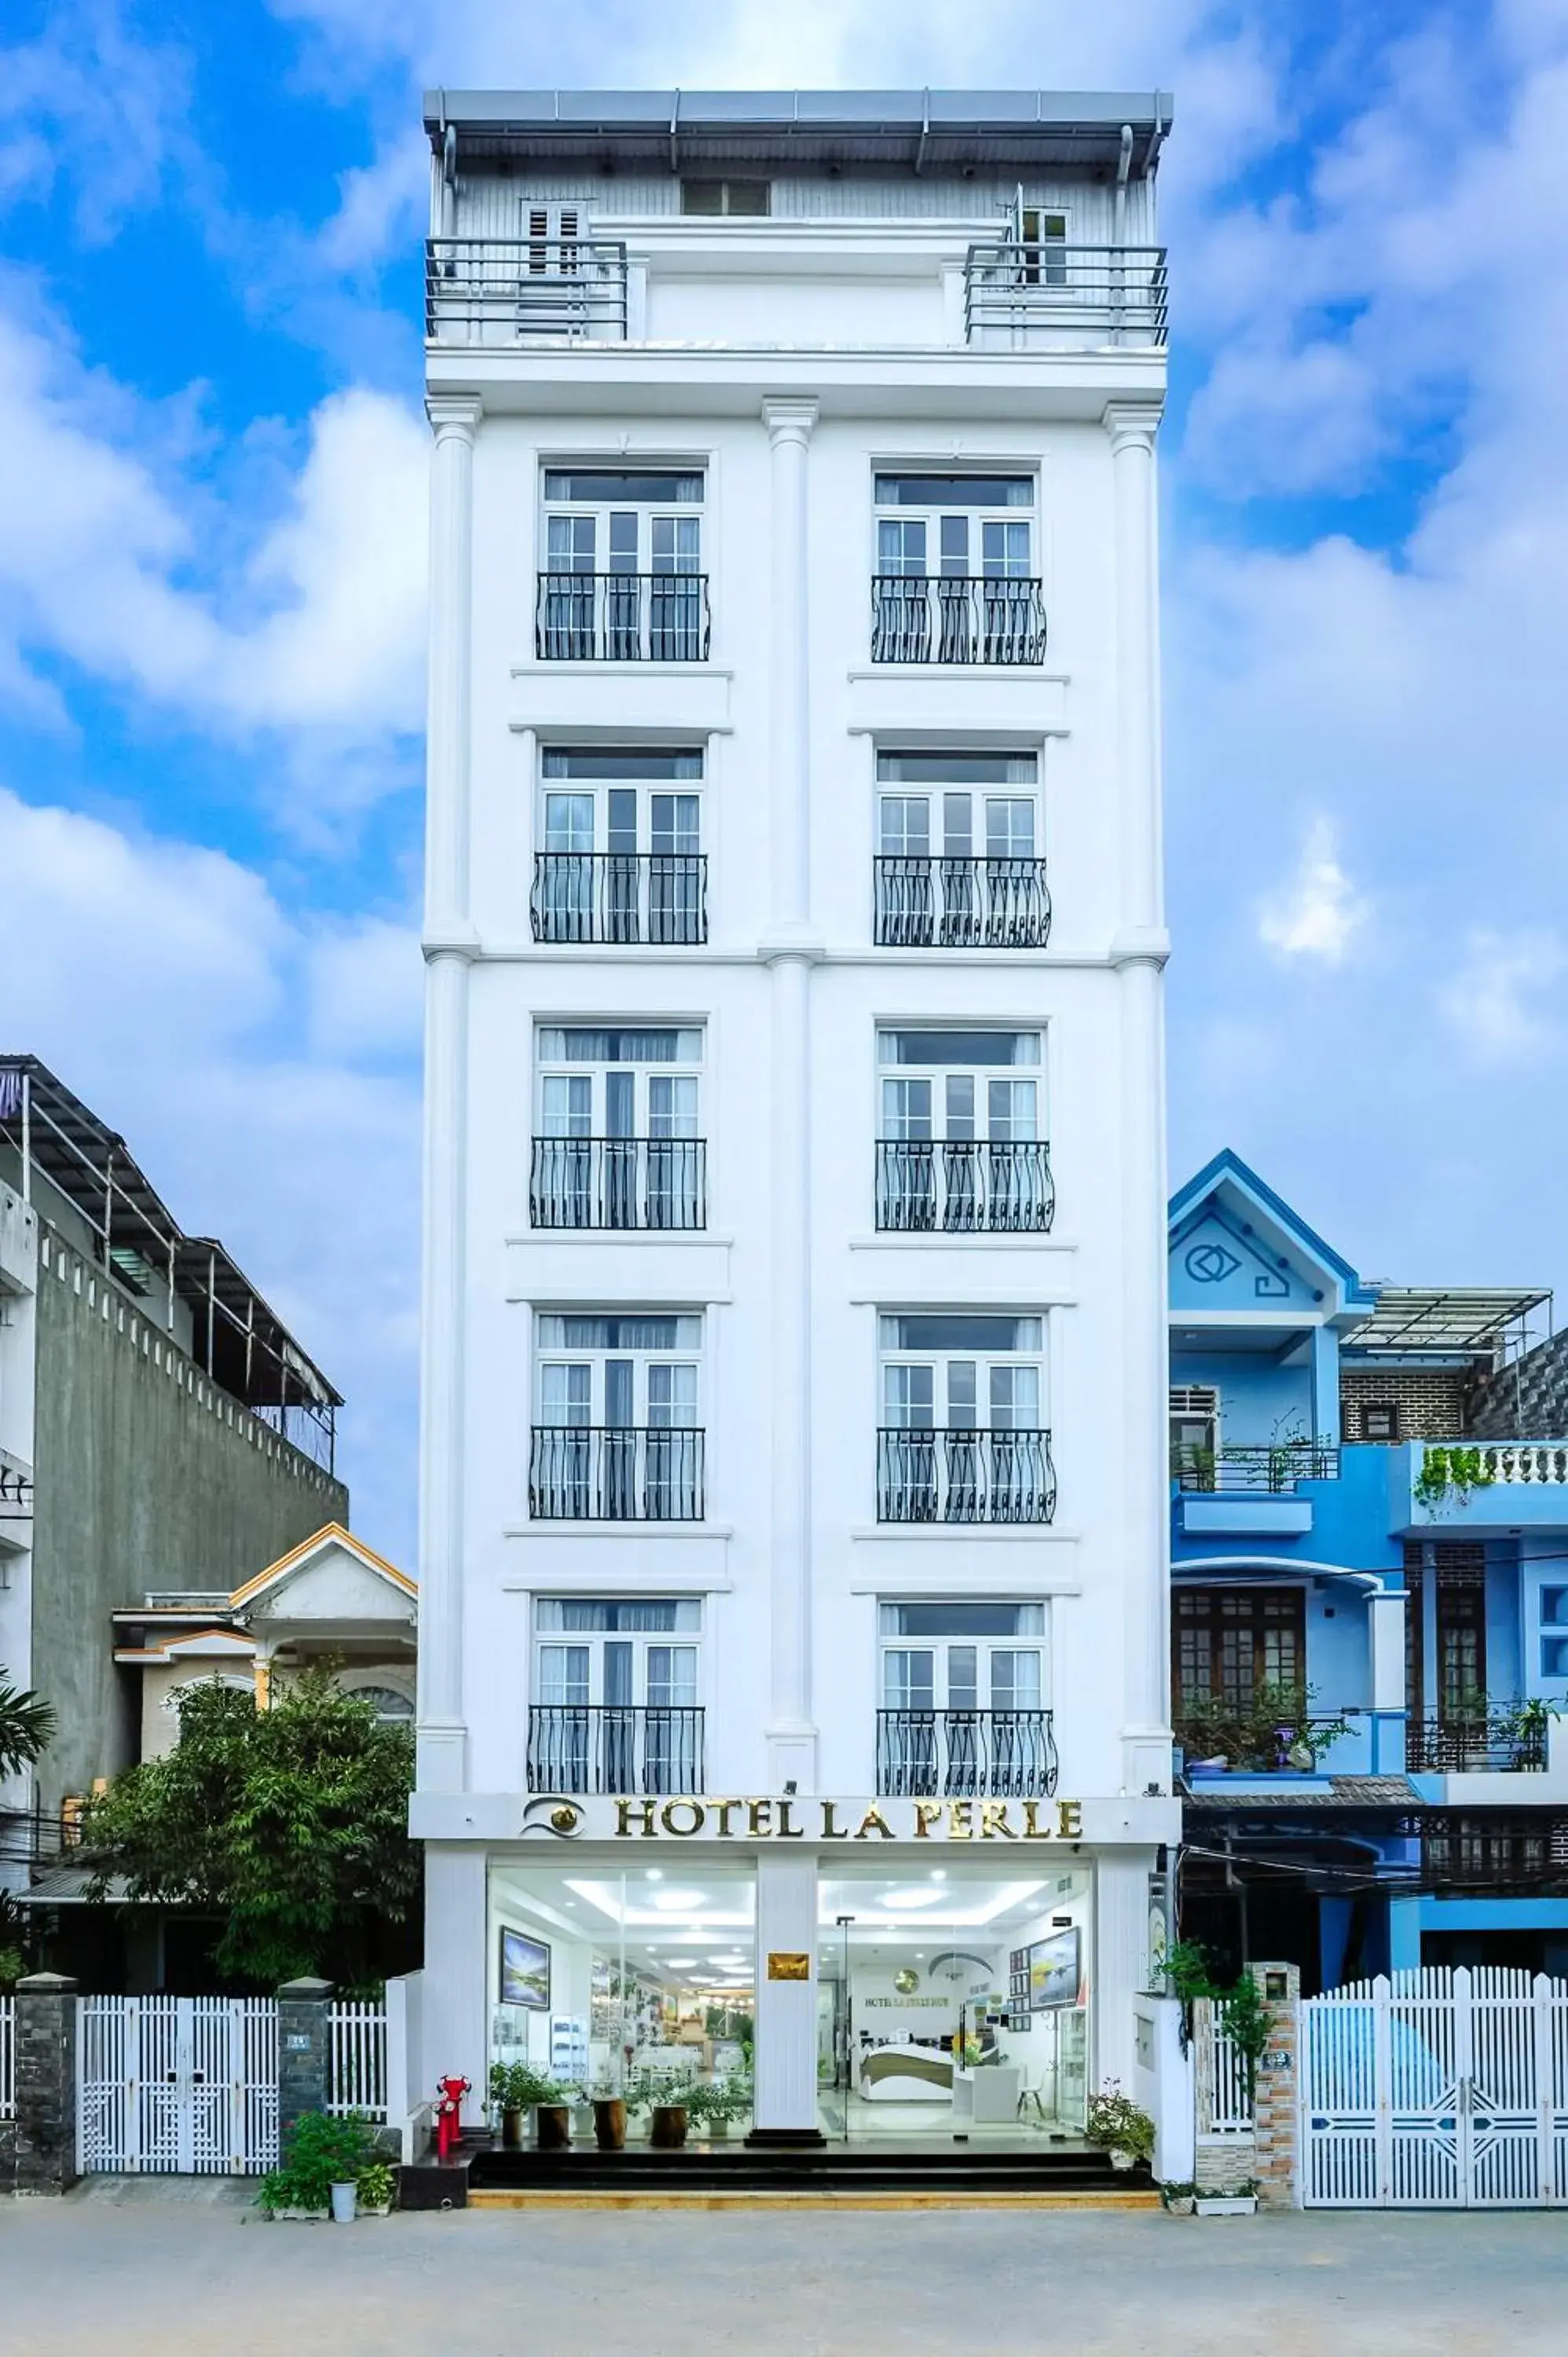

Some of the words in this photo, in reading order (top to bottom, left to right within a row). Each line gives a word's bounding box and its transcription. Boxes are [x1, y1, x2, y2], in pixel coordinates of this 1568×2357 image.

[614, 1798, 804, 1837] HOTEL
[820, 1799, 896, 1838] LA
[913, 1799, 1083, 1839] PERLE
